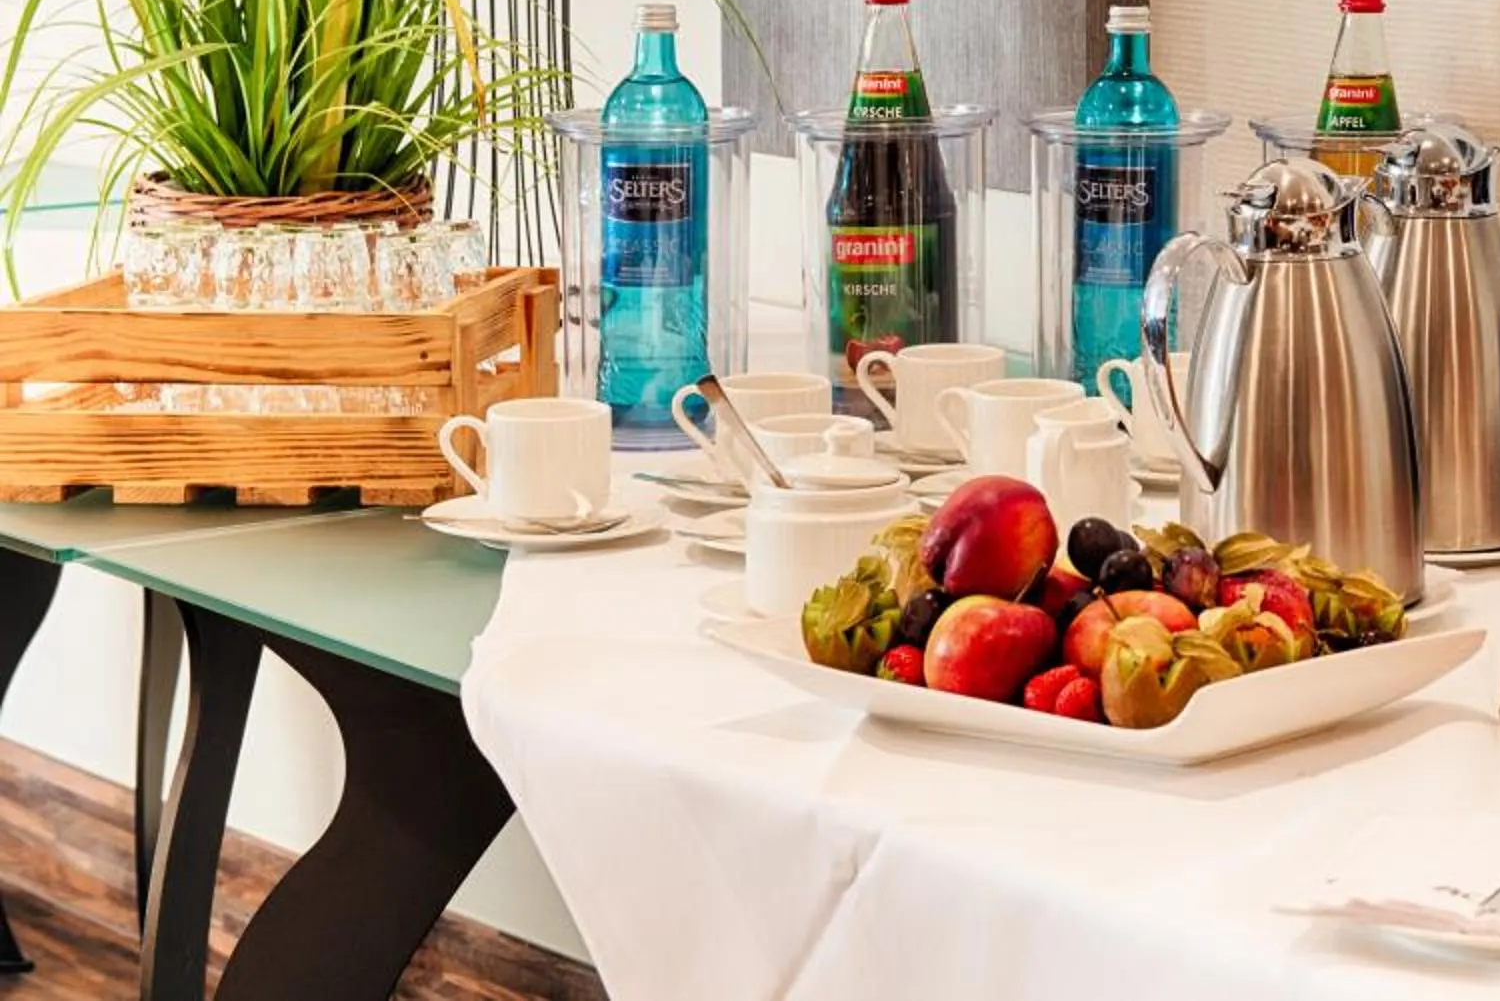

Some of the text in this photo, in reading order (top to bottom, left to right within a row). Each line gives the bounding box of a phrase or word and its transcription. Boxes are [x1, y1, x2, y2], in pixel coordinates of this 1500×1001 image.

[609, 177, 687, 204] SELTERS
[1078, 179, 1149, 207] SELTERS
[836, 236, 906, 261] granini
[842, 283, 898, 297] KIRSCHE
